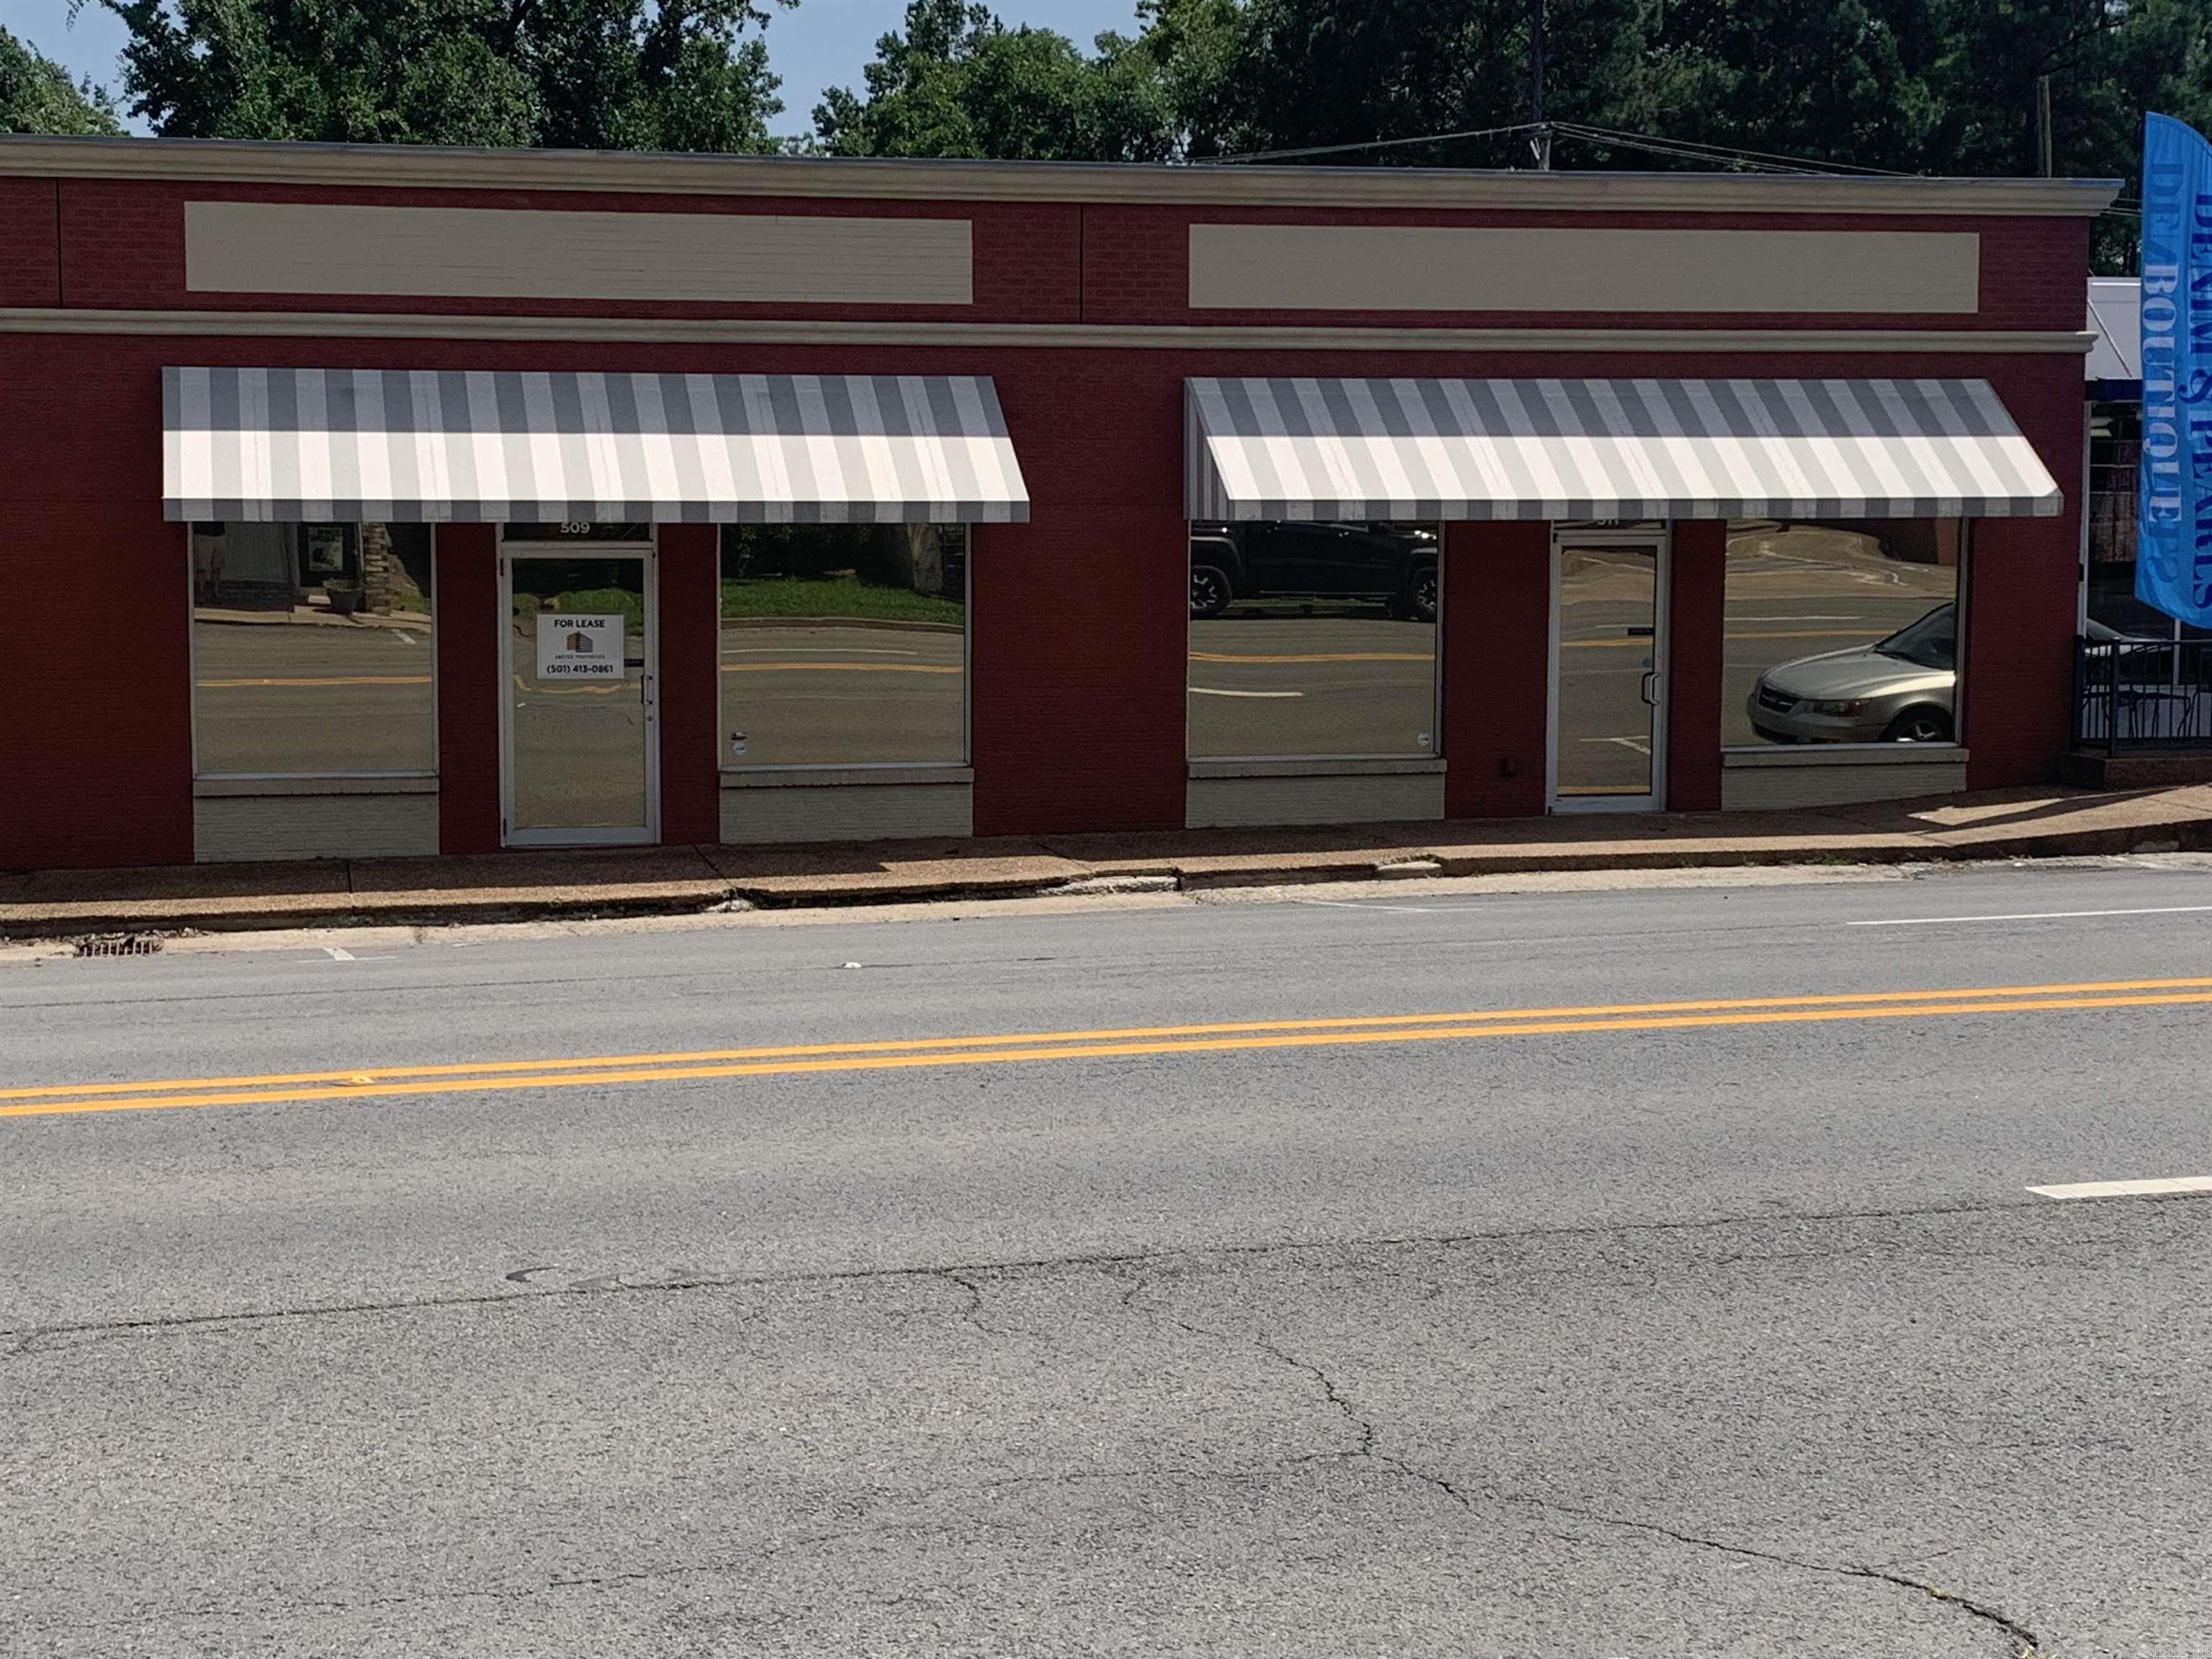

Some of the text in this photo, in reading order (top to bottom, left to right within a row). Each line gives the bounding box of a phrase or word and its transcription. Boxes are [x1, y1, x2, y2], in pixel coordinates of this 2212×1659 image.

[2142, 265, 2182, 522] BOUTIQUE
[560, 522, 590, 534] 509
[554, 619, 606, 628] FOR LEASE
[547, 664, 613, 674] (501) 413-0861
